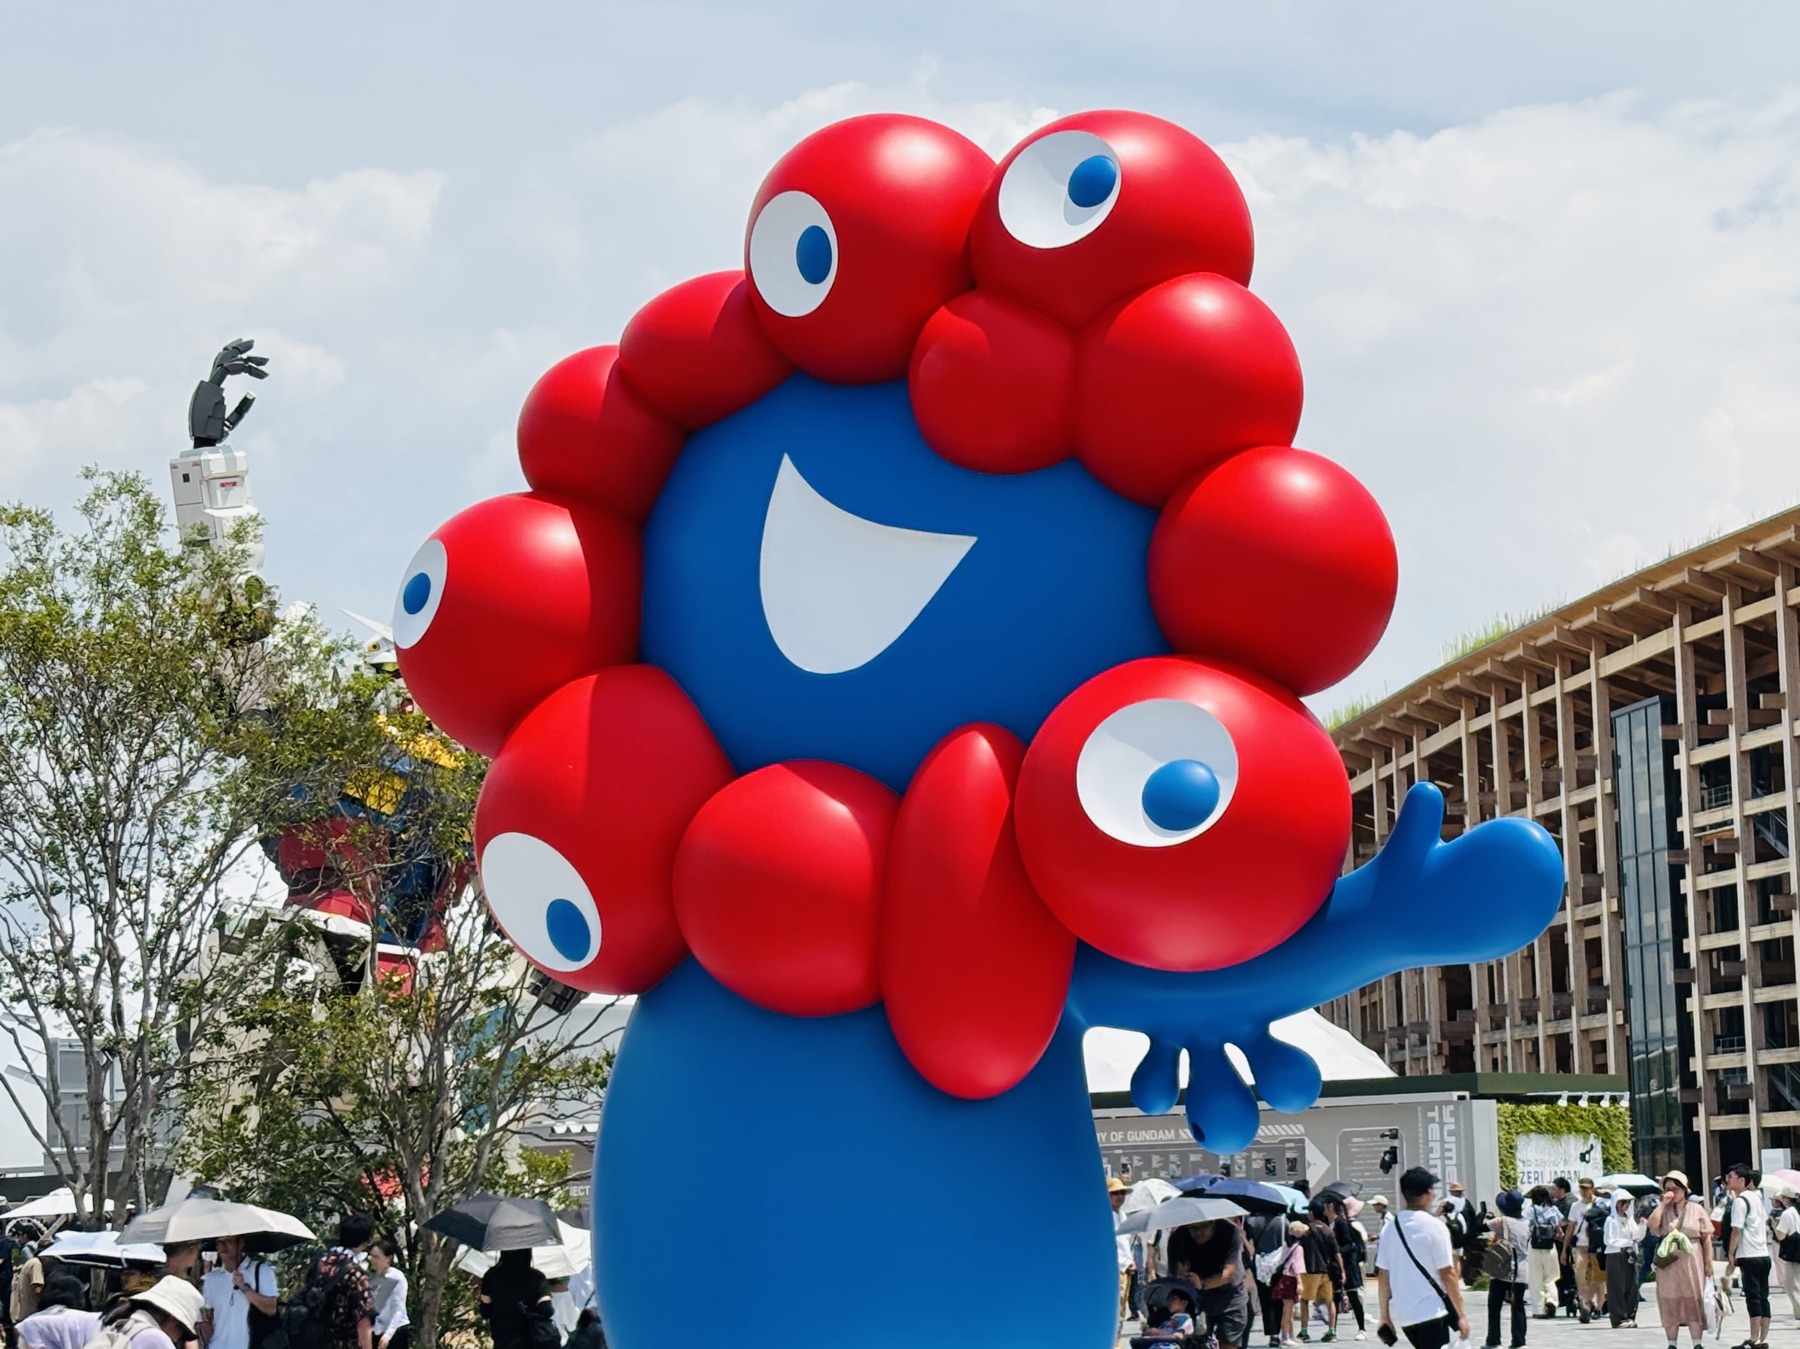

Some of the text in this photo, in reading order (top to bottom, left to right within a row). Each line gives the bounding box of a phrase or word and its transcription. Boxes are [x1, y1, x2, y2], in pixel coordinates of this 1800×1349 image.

[1110, 1131, 1125, 1142] OF
[1127, 1129, 1175, 1141] GUNDAM
[1520, 1169, 1581, 1185] ZERI JAPAN
